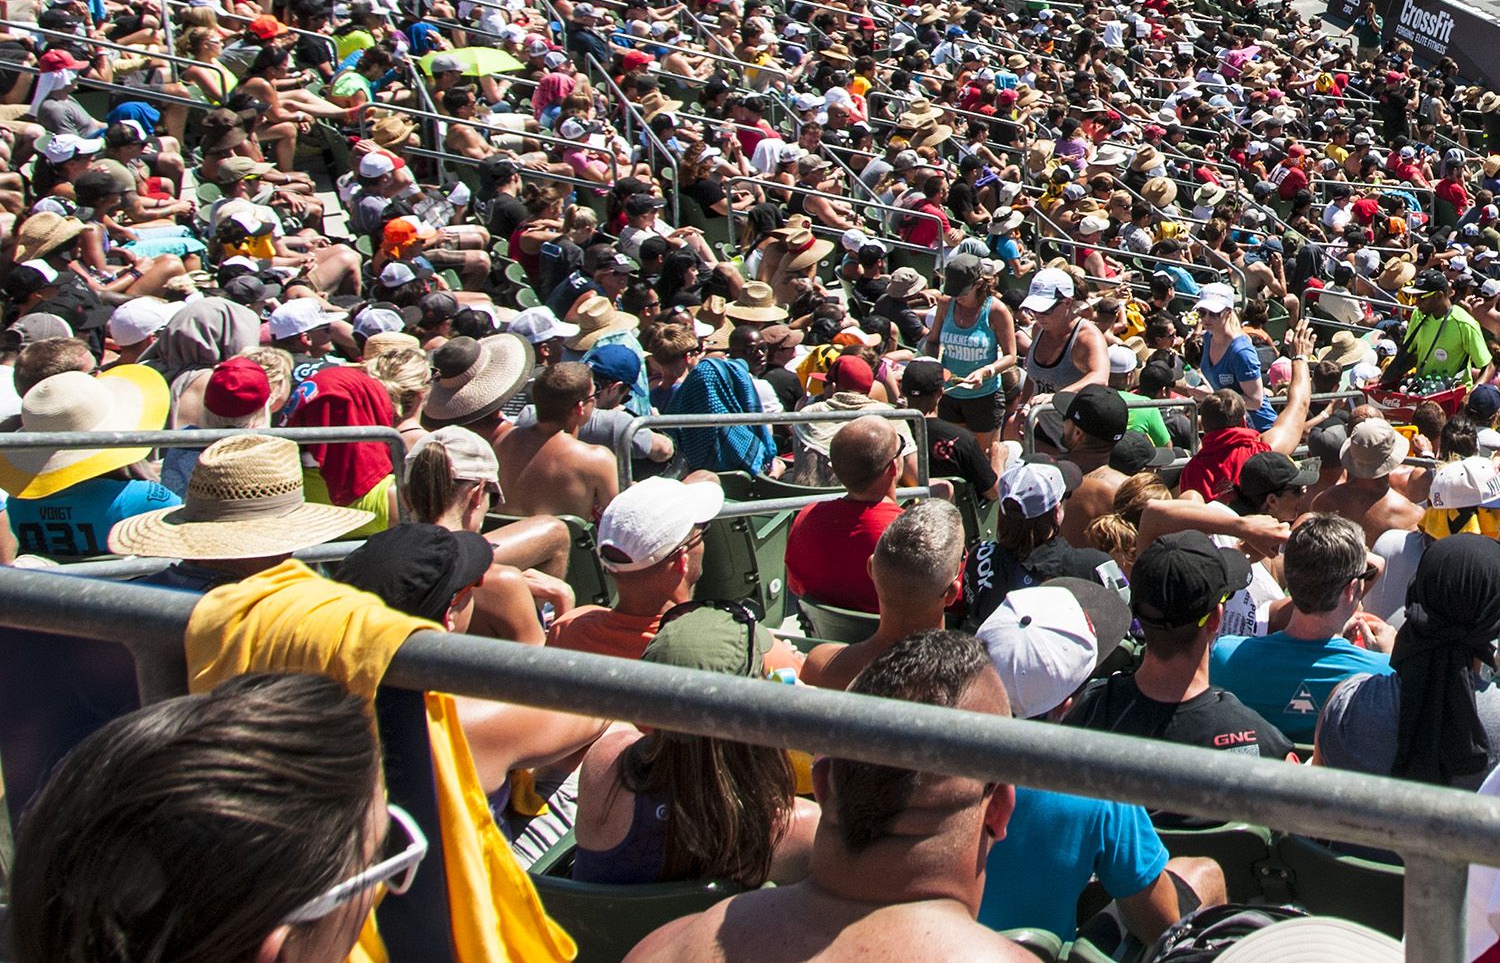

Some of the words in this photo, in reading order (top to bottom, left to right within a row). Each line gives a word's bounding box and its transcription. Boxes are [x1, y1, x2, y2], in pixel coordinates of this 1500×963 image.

[947, 345, 989, 363] CHOICE
[39, 506, 72, 521] VOIGT
[1213, 729, 1257, 747] GNC
